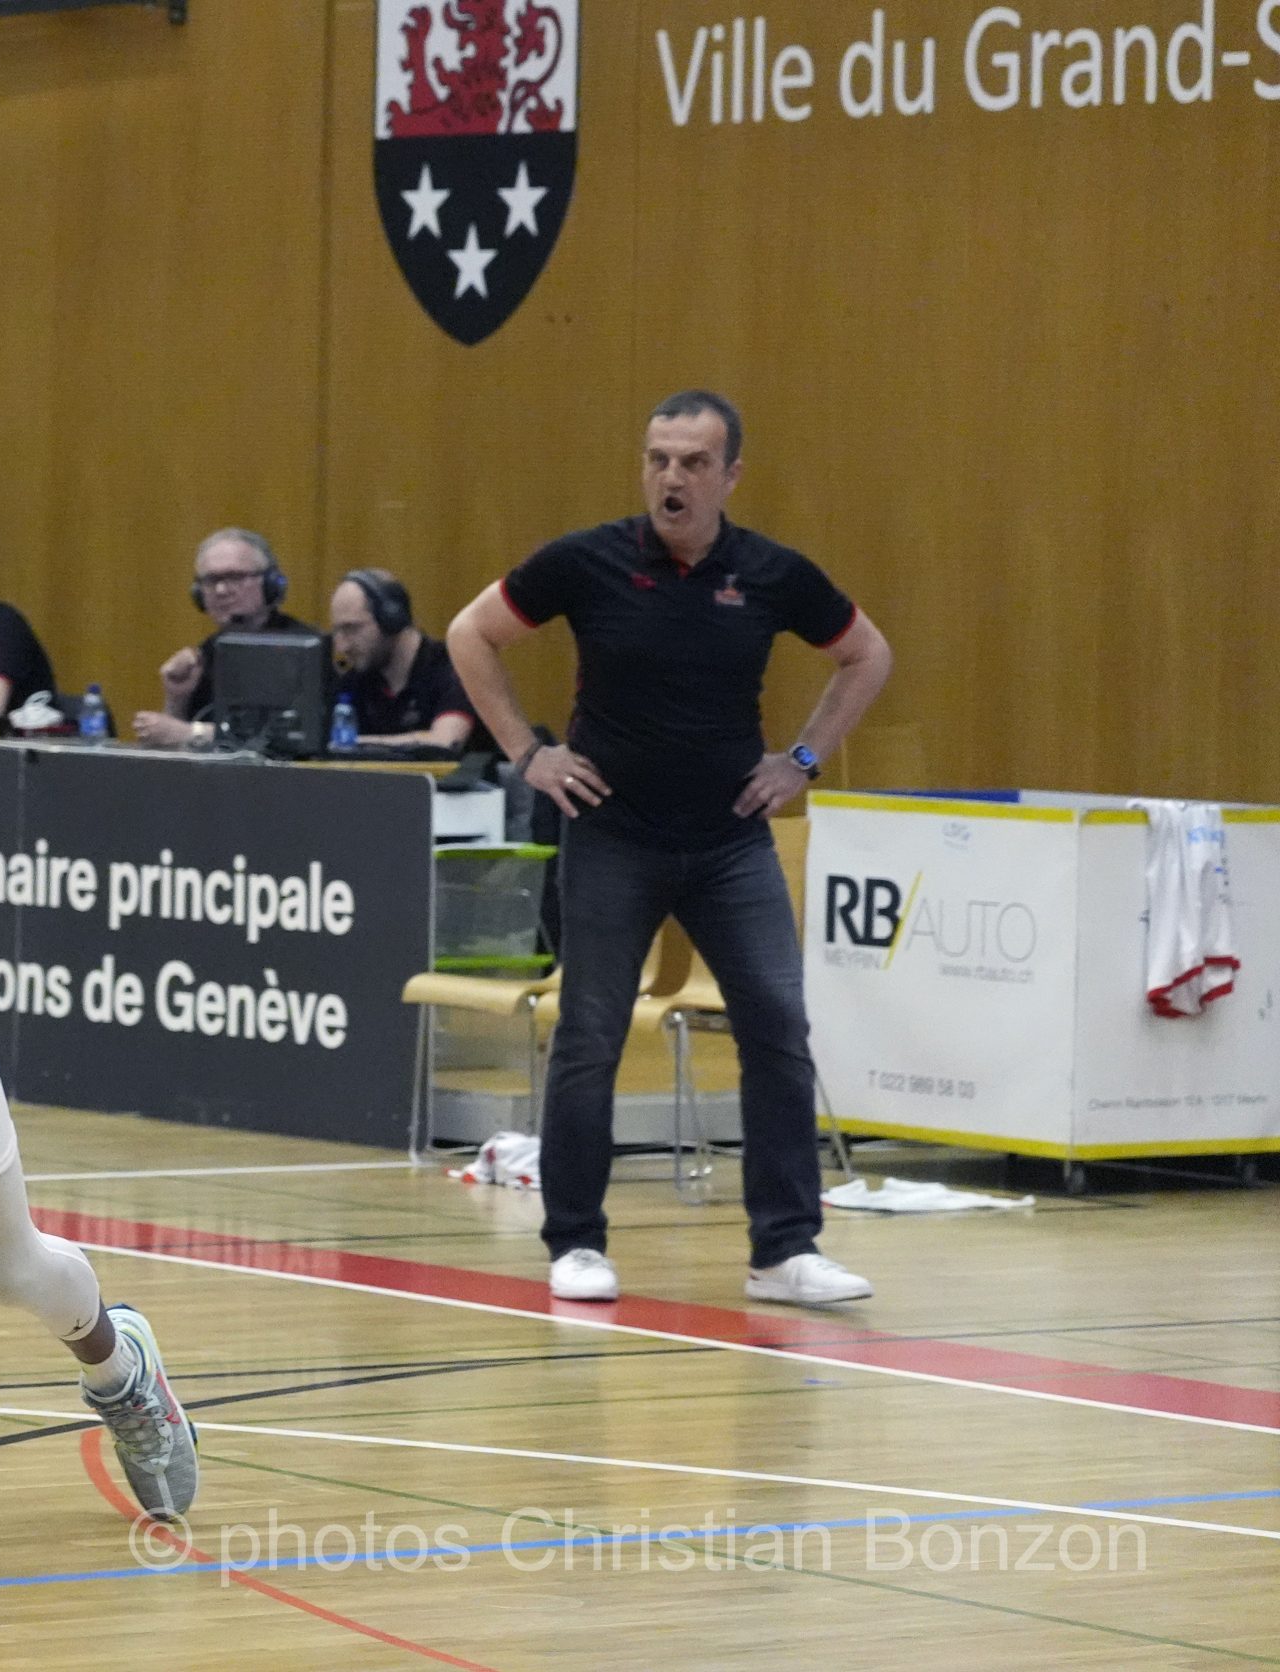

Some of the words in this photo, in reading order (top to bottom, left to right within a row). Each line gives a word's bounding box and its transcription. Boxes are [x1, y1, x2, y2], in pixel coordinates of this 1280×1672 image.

[655, 15, 815, 127] Ville
[839, 9, 936, 118] du
[109, 848, 355, 943] principale
[83, 954, 144, 1027] de
[156, 960, 349, 1050] Genève
